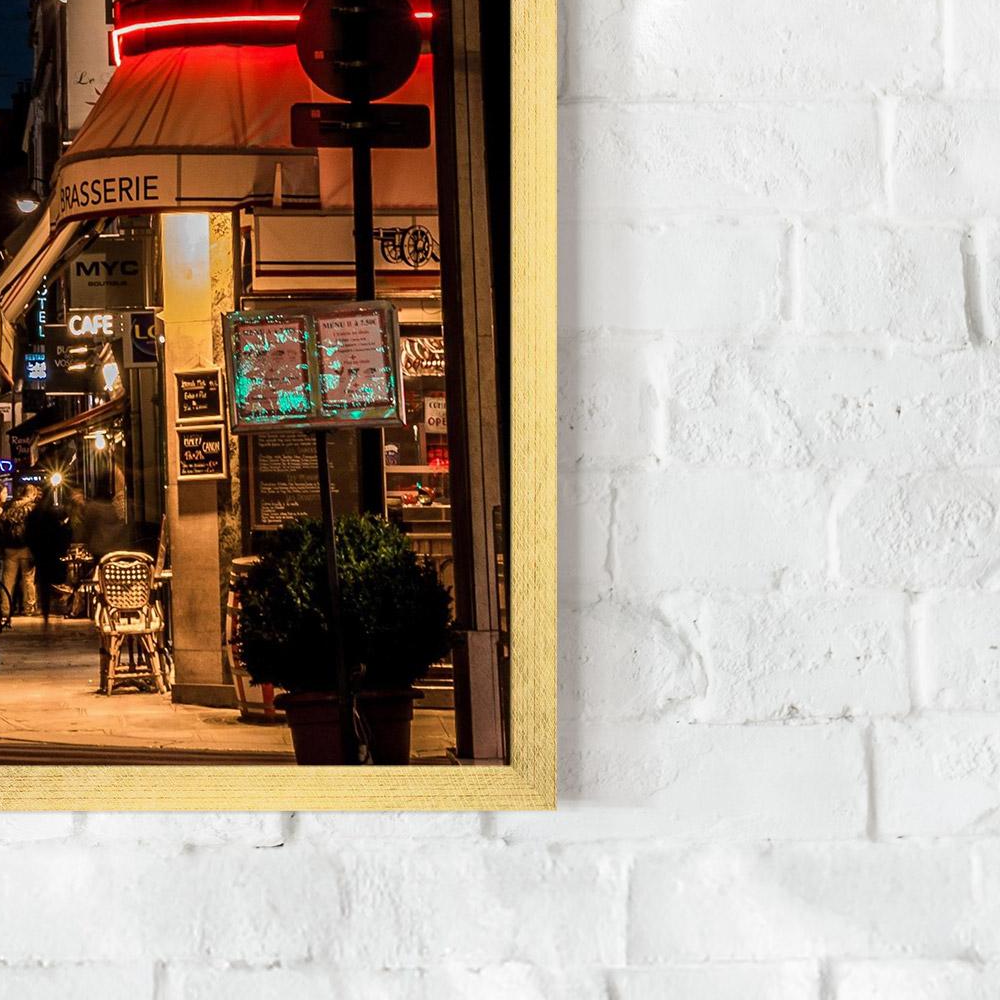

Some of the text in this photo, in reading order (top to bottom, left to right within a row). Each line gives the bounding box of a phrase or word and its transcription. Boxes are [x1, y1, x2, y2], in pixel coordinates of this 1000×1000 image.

[60, 175, 159, 213] BRASSERIE
[76, 261, 139, 276] MYC
[69, 315, 114, 336] CAFE
